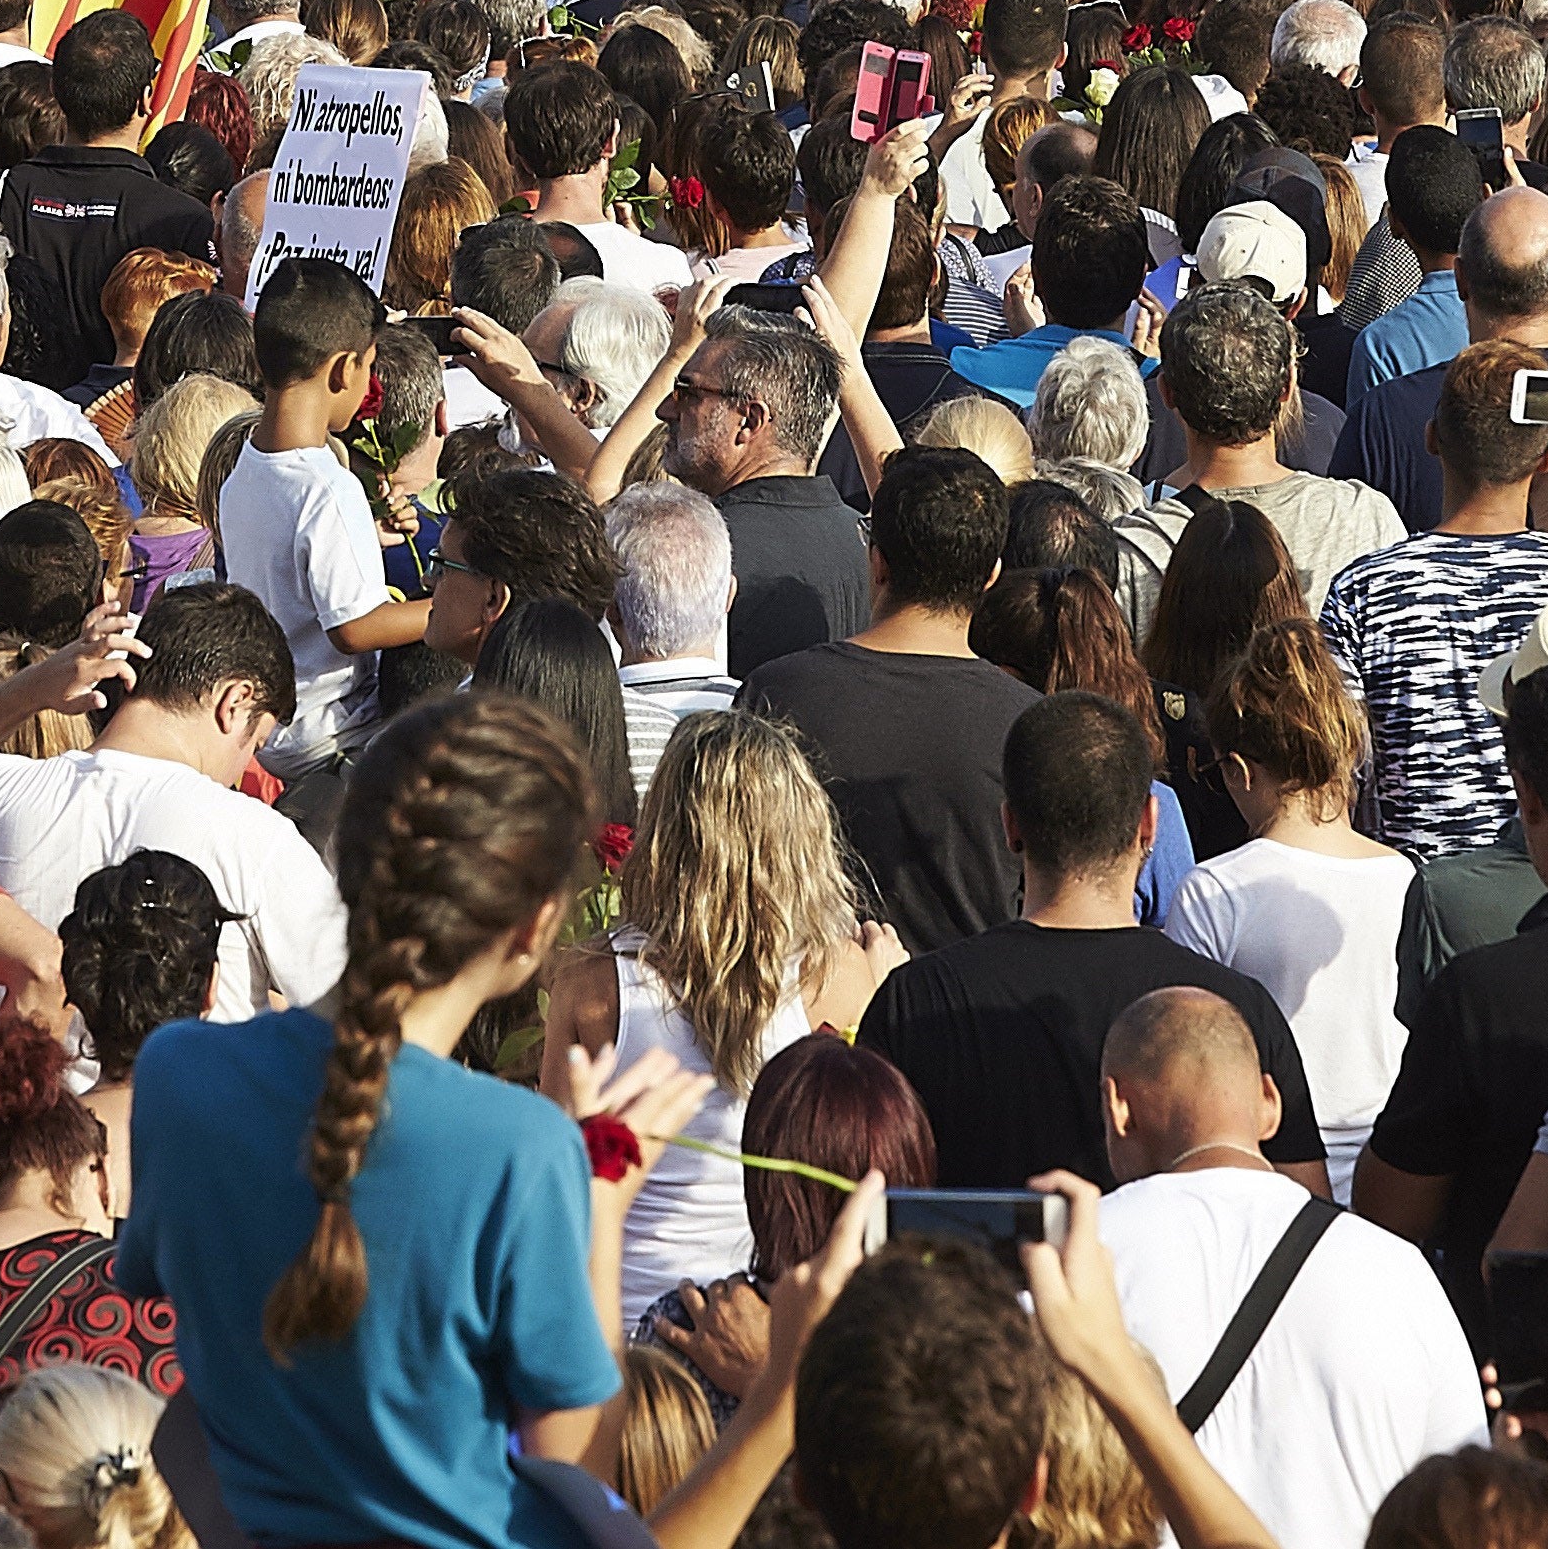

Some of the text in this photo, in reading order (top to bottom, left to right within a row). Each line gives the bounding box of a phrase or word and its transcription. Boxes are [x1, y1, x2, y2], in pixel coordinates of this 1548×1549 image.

[292, 89, 404, 148] Ni atropellos,
[273, 158, 394, 210] ni bombardeos:
